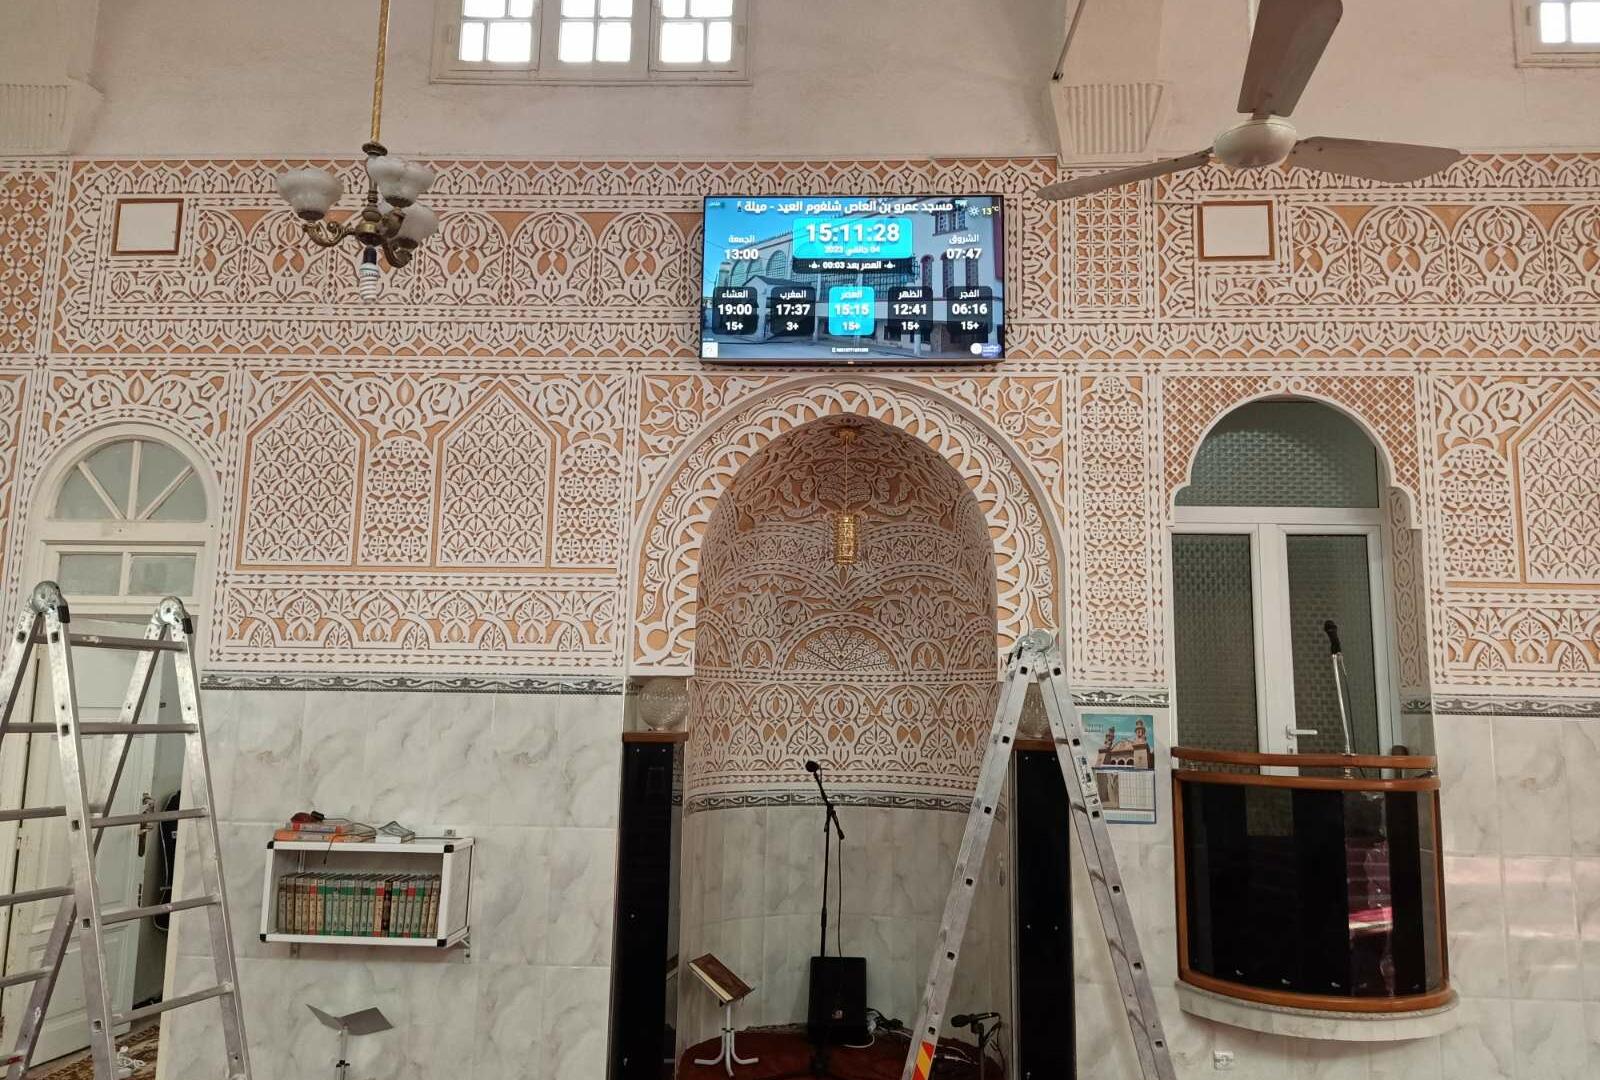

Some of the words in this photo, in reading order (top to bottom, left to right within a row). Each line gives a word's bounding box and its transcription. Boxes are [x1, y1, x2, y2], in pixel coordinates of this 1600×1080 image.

[744, 200, 767, 214] ميلة
[777, 200, 803, 214] العيد
[806, 200, 841, 214] شلغوم
[845, 201, 876, 214] العاص
[879, 201, 892, 214] بن
[894, 202, 919, 213] عمرو
[920, 202, 953, 213] مسجد
[806, 223, 900, 242] 15:11:28
[728, 235, 755, 244] الجمعة
[949, 234, 979, 245] الشروق
[725, 249, 759, 260] 13:00
[946, 248, 982, 260] 07:47
[822, 261, 845, 269] 00:03
[861, 261, 882, 271] العصر
[722, 290, 748, 298] العشاء
[780, 290, 807, 300] المغرب
[898, 290, 923, 300] الظهر
[960, 290, 980, 300] الفجر
[718, 304, 752, 315] 19:00
[776, 304, 811, 315] 17:37
[893, 304, 927, 315] 12:41
[952, 303, 988, 315] 06:16
